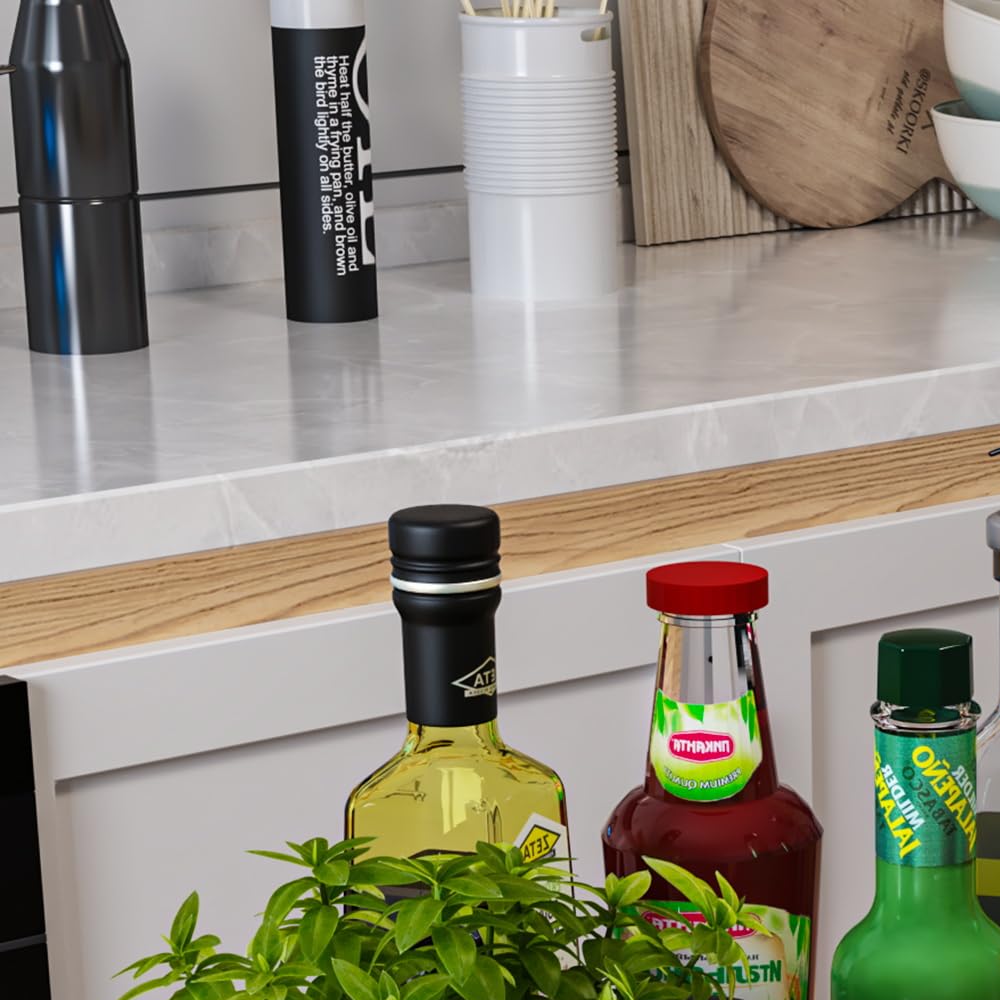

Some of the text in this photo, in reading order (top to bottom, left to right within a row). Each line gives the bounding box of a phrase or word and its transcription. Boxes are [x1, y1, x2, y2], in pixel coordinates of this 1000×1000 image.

[314, 56, 333, 234] the bird lightly on all sides.
[326, 56, 347, 276] thyme in a frying pan, and brown
[338, 55, 360, 272] Heat half the butter, olive oil and
